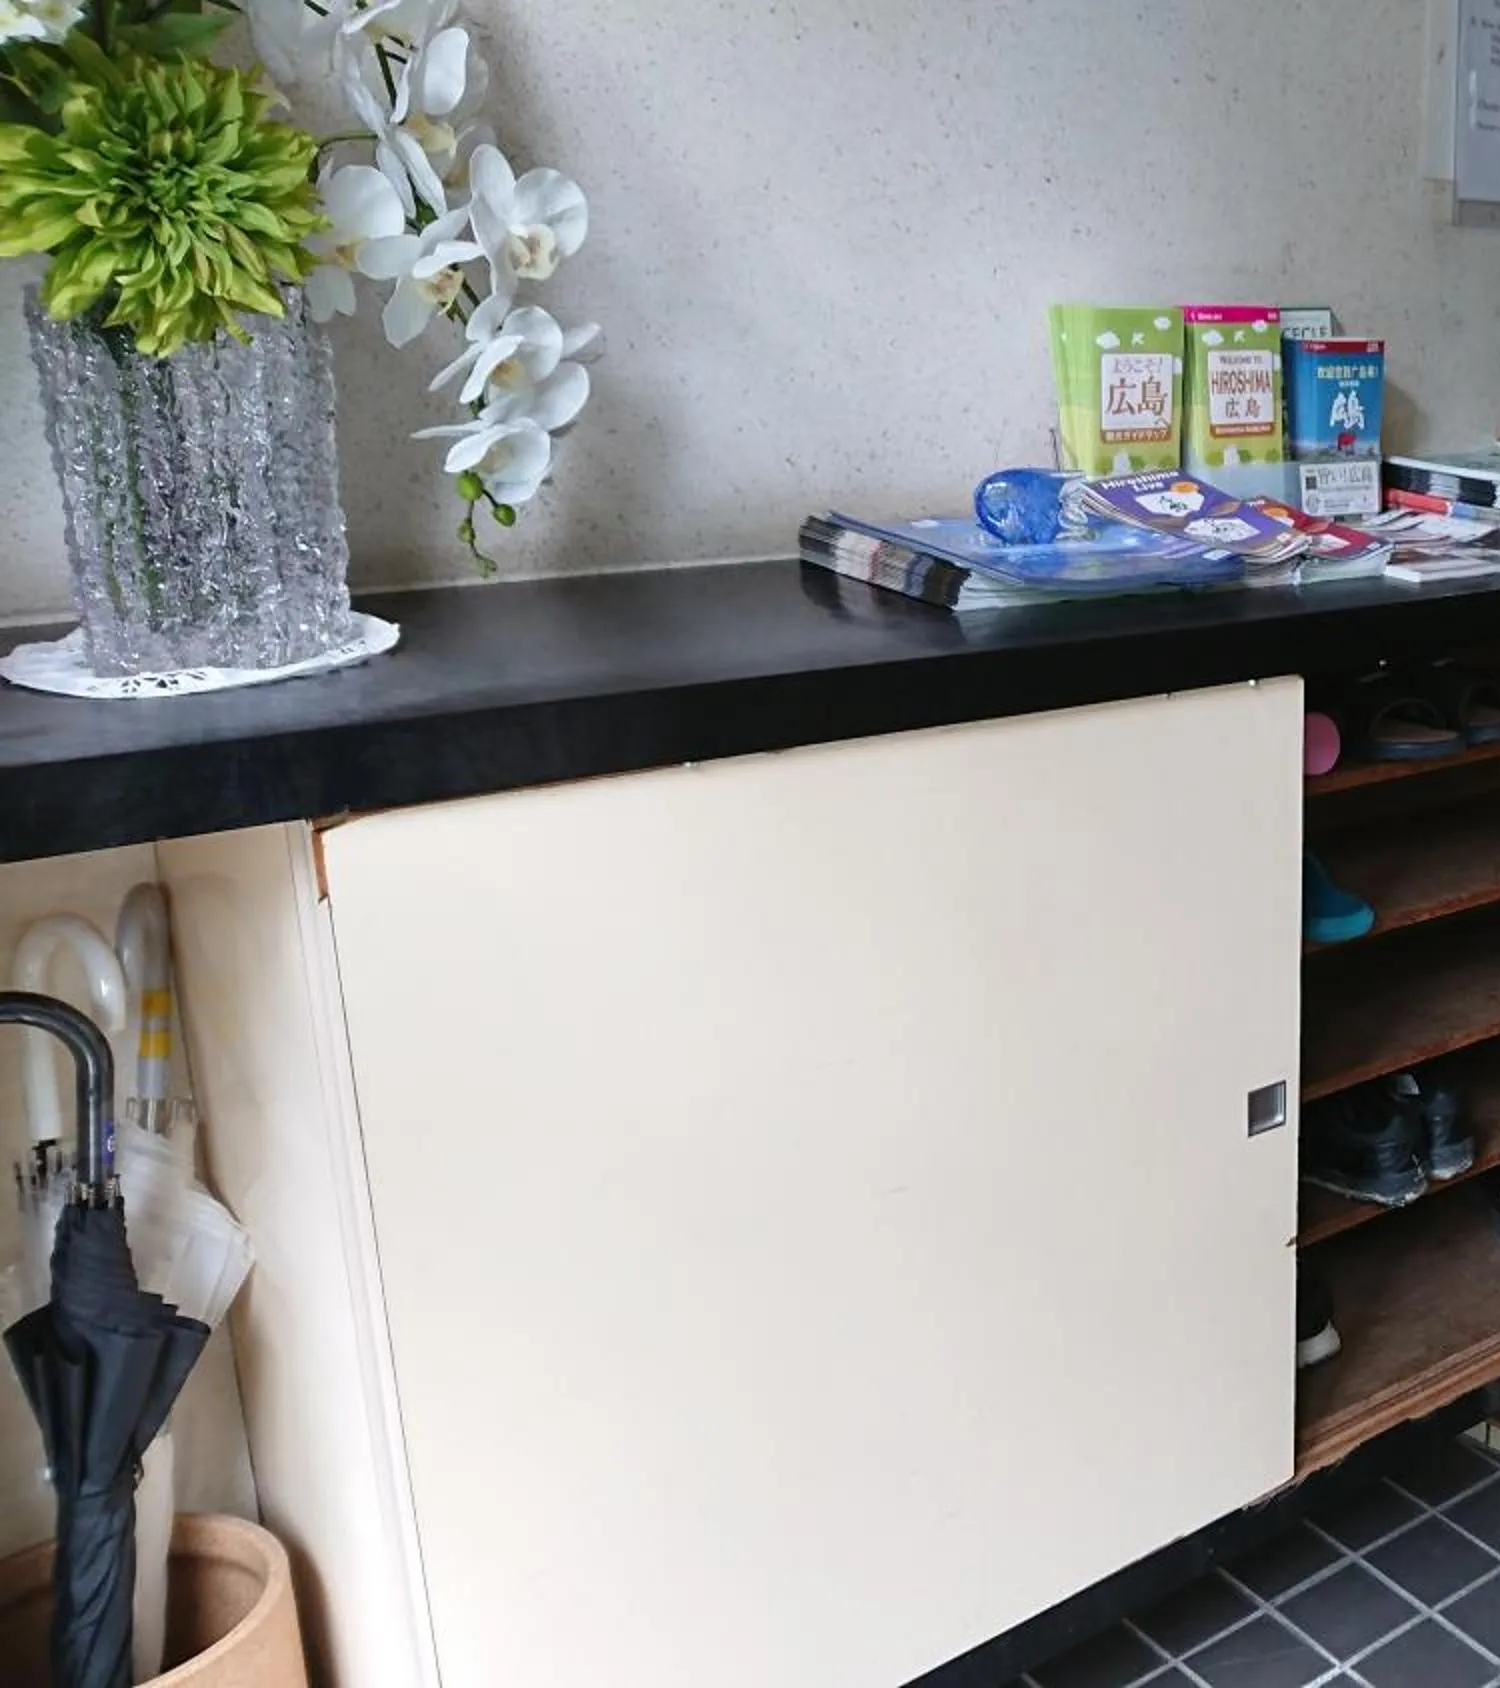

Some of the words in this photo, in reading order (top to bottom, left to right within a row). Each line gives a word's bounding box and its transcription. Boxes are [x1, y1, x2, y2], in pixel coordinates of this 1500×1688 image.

[1211, 369, 1271, 395] HIROSHIMA
[1105, 376, 1169, 417] 広島
[1225, 396, 1262, 419] 広島
[1101, 470, 1180, 490] Hiroshima
[1133, 481, 1165, 493] Live
